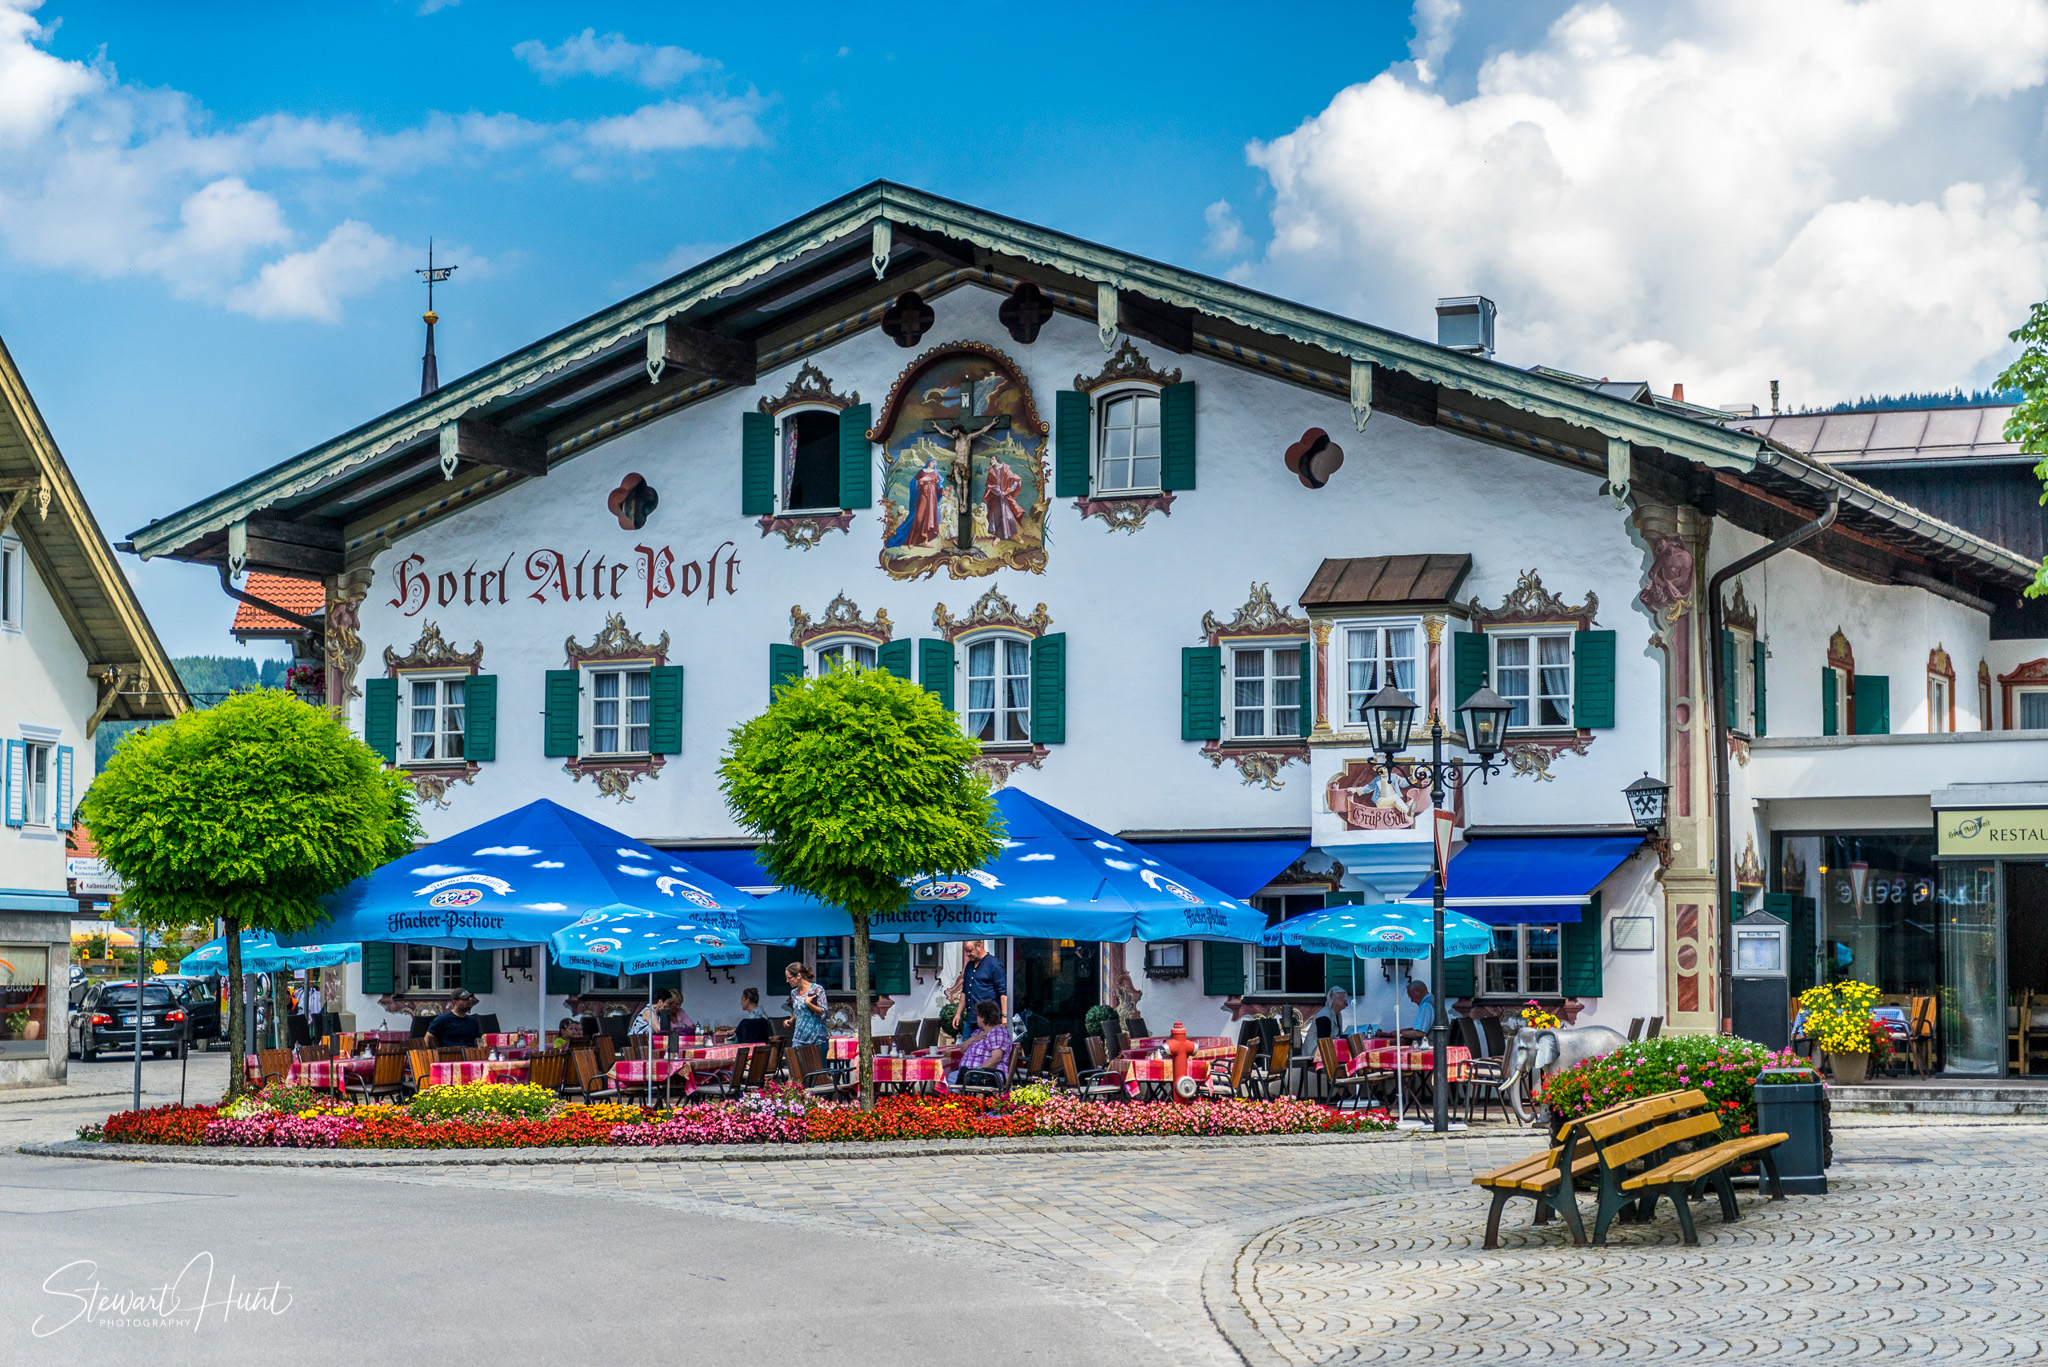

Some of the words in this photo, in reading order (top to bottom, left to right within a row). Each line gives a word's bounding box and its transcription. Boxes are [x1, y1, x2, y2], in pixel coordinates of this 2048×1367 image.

[385, 551, 515, 617] Hotel
[525, 548, 629, 605] Alte
[1353, 807, 1382, 829] Grüß
[1383, 810, 1408, 827] Gott
[1989, 828, 2048, 842] RESTAU
[387, 910, 505, 933] Hacker-Pschorr
[1361, 944, 1421, 956] Hacker-Pschorr
[1444, 942, 1482, 953] acker-Pschorr
[568, 955, 615, 970] Hacker-Pschorr
[631, 957, 689, 972] Hacker-Pschorr
